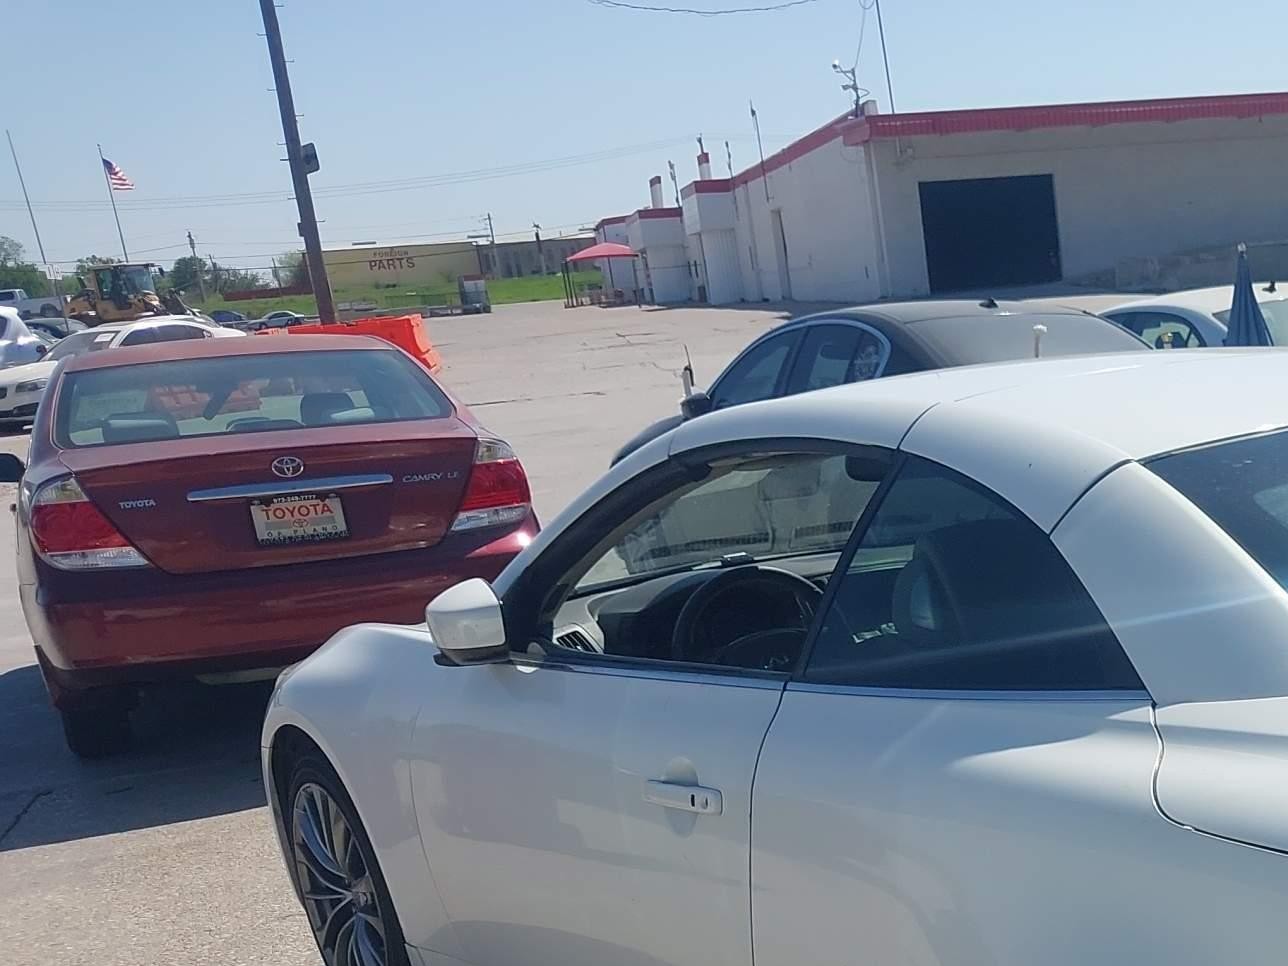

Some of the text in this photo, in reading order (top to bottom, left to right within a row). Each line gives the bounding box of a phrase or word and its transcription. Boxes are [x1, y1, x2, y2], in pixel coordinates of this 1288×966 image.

[368, 257, 416, 271] PARTS
[402, 472, 443, 483] CAMRY
[118, 499, 157, 509] TOYOTA
[261, 503, 334, 521] TOYOTA
